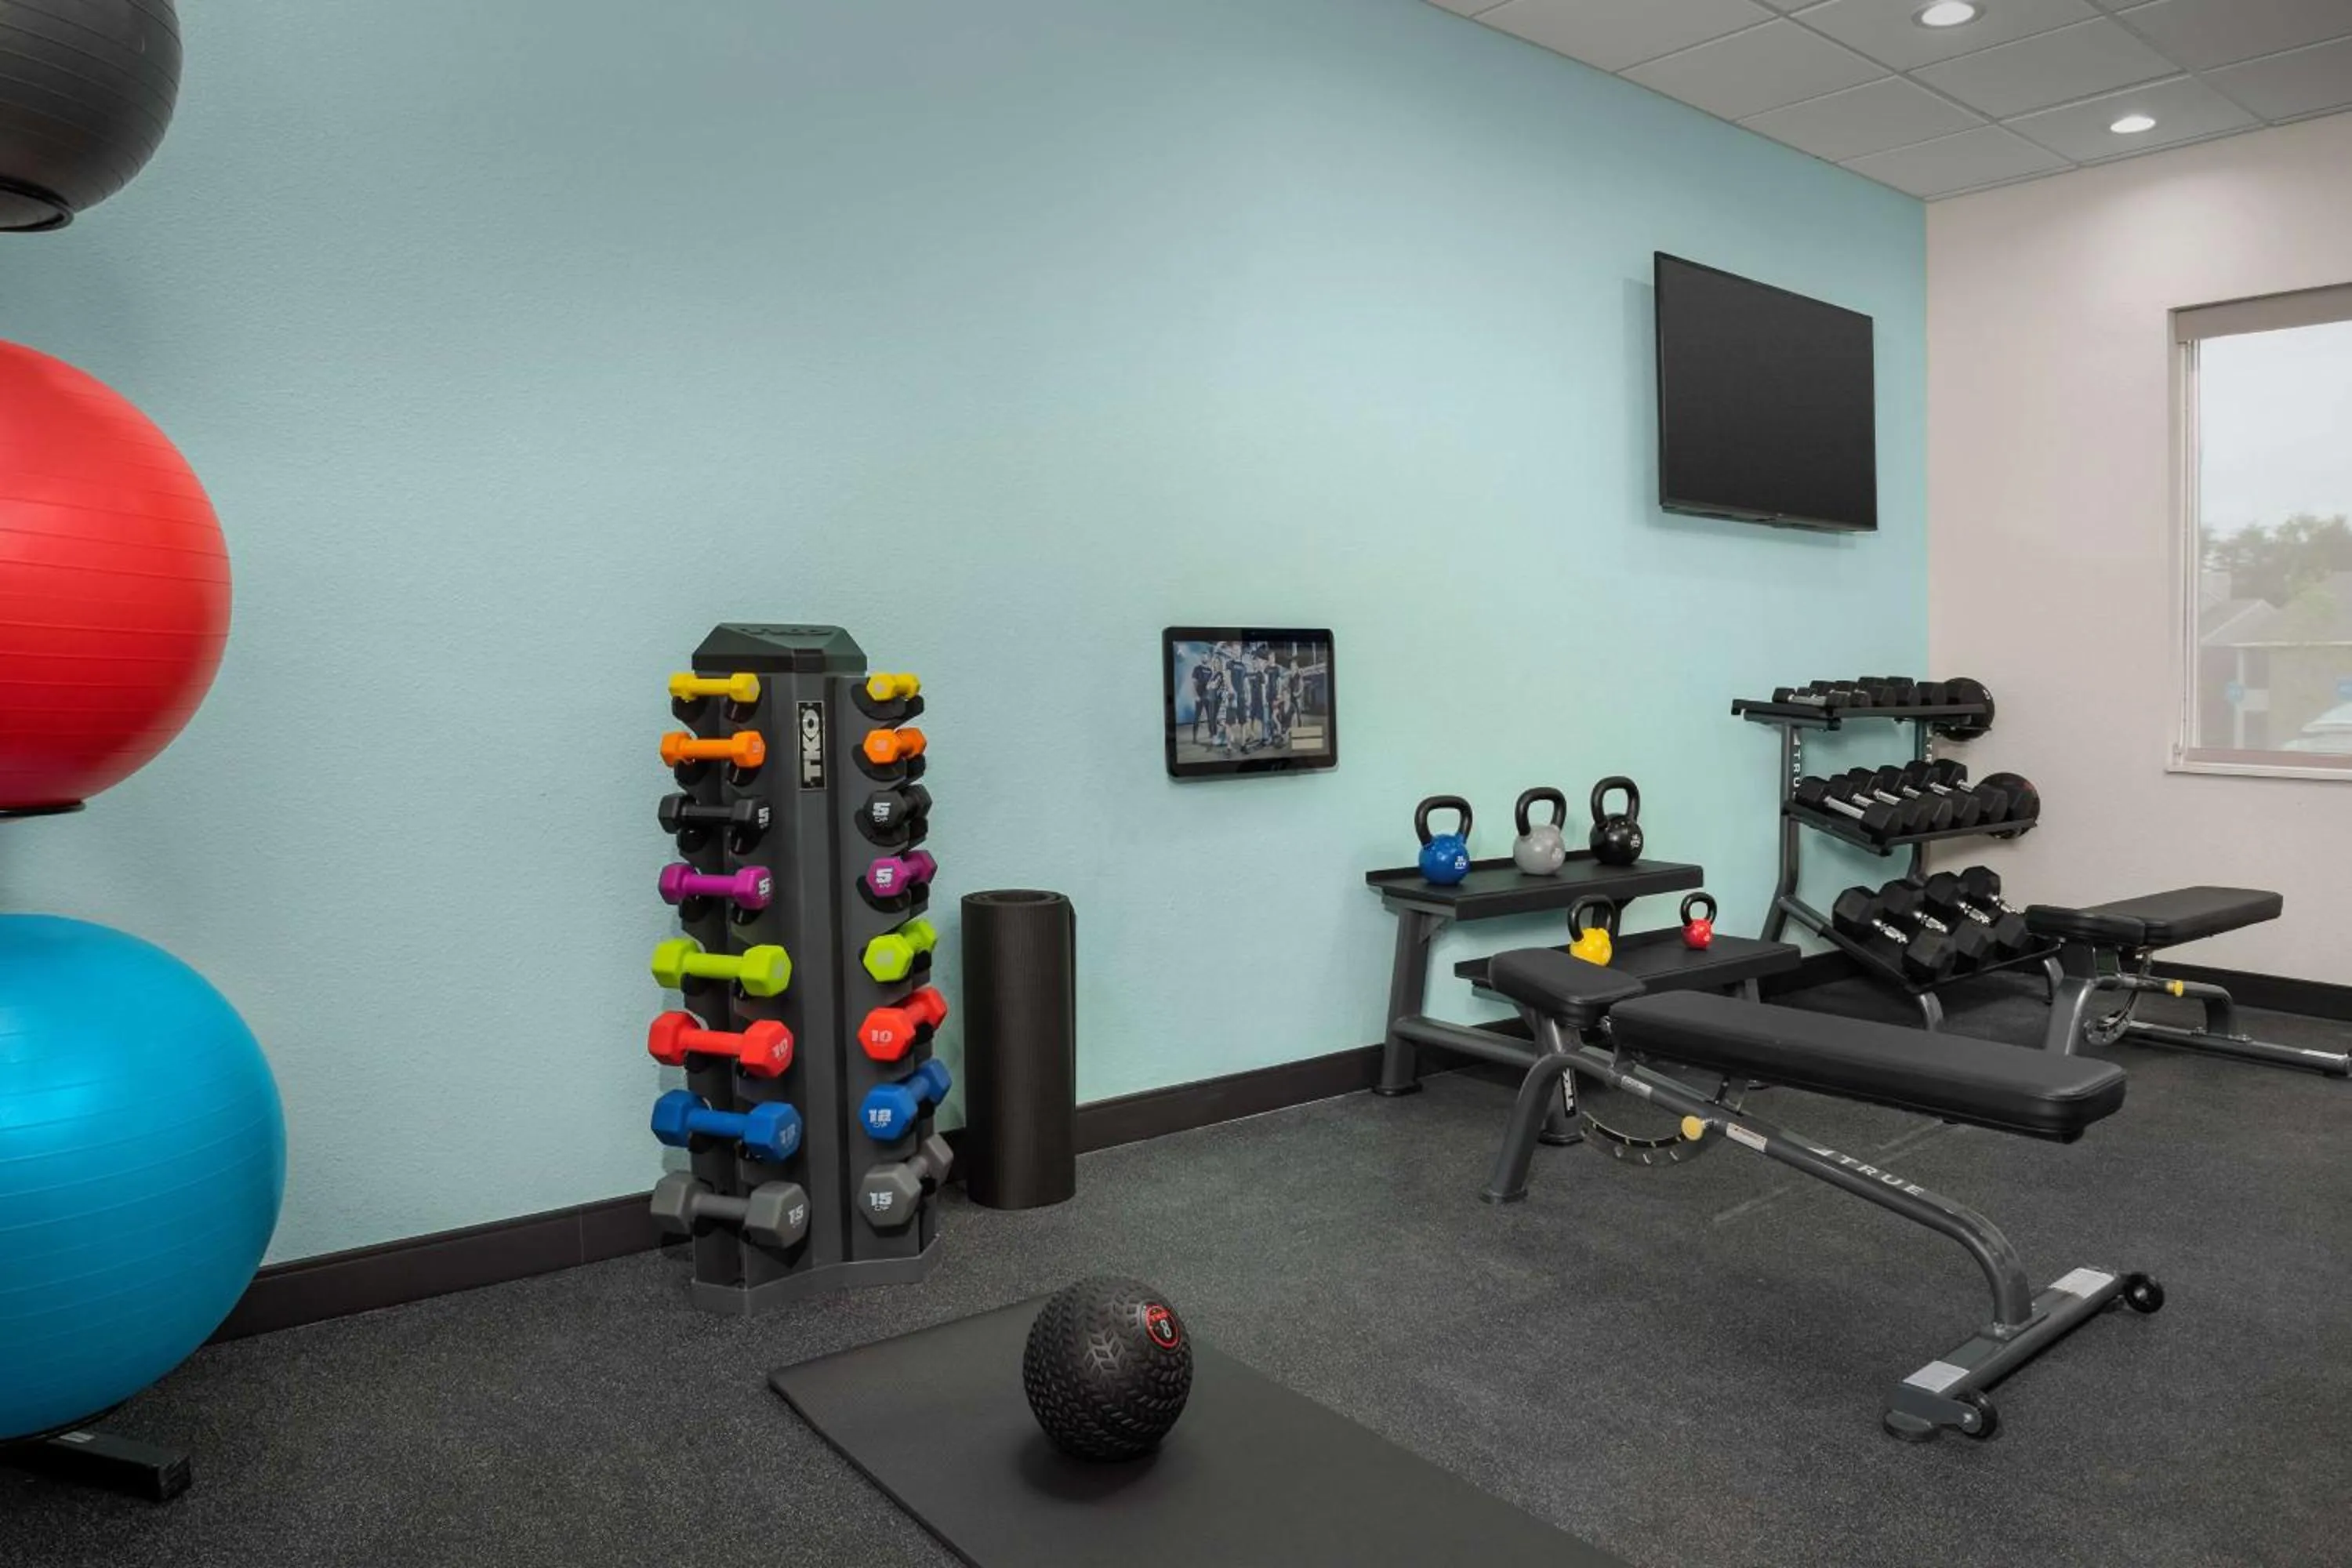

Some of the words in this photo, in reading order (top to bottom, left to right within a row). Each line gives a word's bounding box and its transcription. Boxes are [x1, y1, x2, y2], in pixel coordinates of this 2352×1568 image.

[802, 709, 822, 782] TKO
[758, 807, 769, 824] 5
[873, 802, 891, 816] 5
[876, 868, 894, 884] 5
[758, 878, 770, 895] 5
[871, 1029, 893, 1042] 10
[1841, 1155, 1925, 1196] TRUE
[869, 1192, 893, 1206] 15
[788, 1204, 804, 1225] 15
[1160, 1319, 1172, 1338] 8
